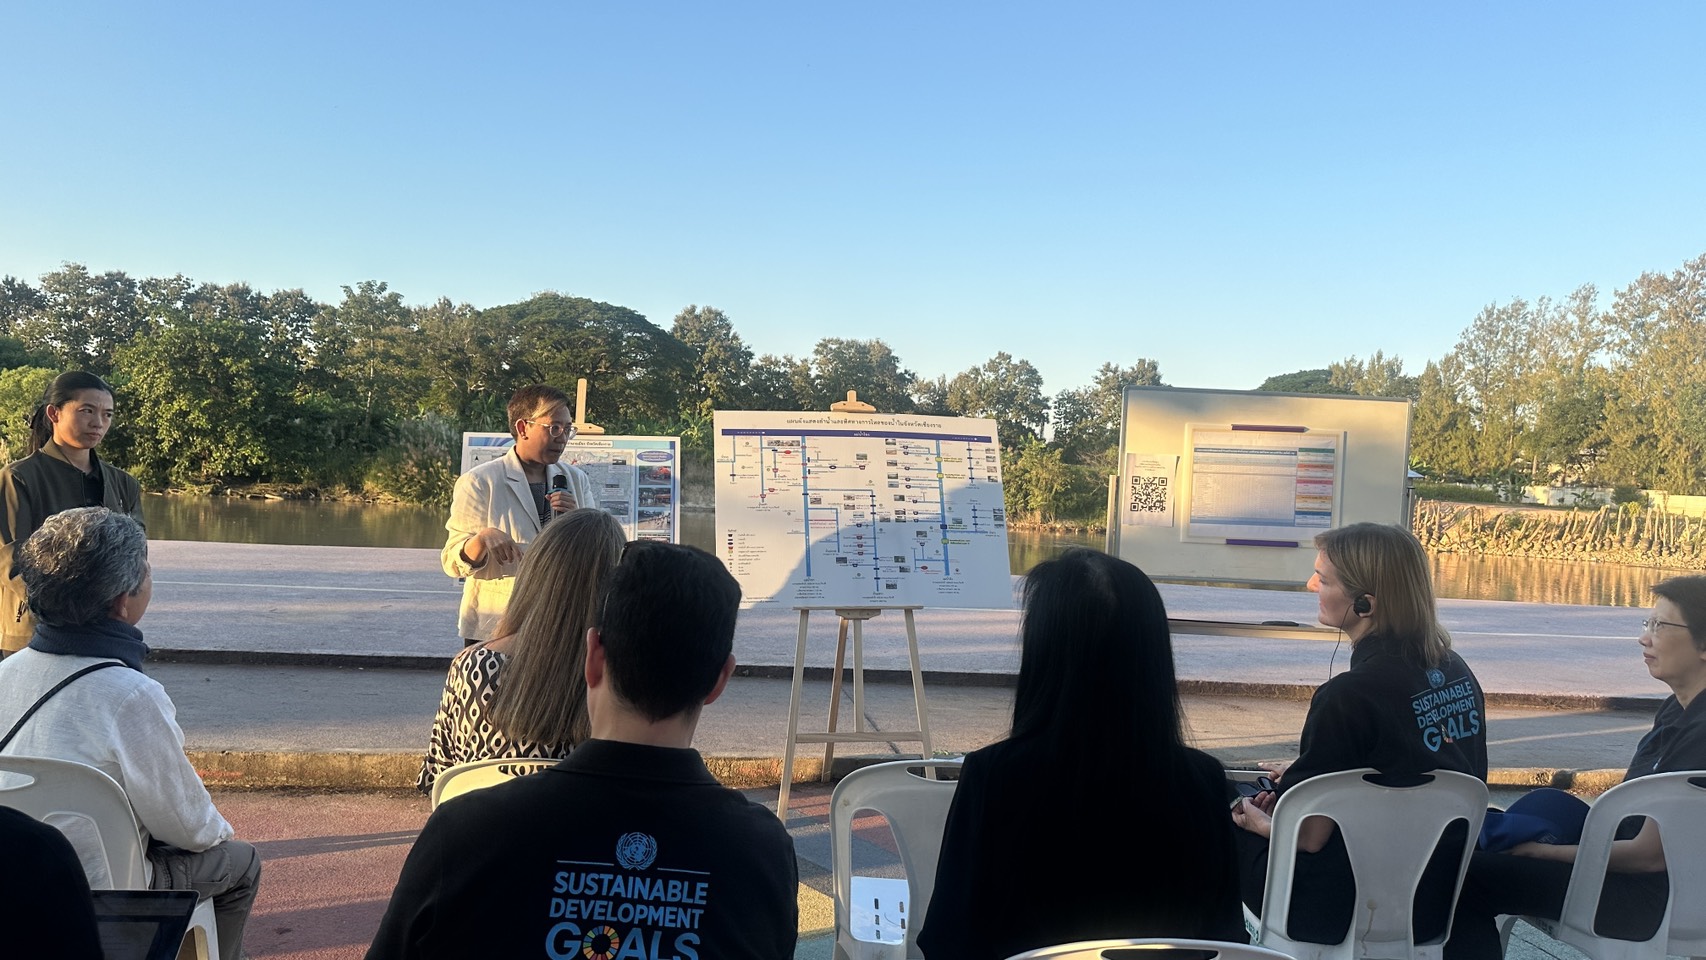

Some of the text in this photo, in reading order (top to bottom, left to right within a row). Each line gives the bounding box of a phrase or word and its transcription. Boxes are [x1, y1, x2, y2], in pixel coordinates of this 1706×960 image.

[1412, 682, 1473, 715] SUSTAINABLE
[553, 871, 709, 905] SUSTAINABLE
[549, 897, 704, 929] DEVELOPMENT
[545, 921, 701, 960] GOALS
